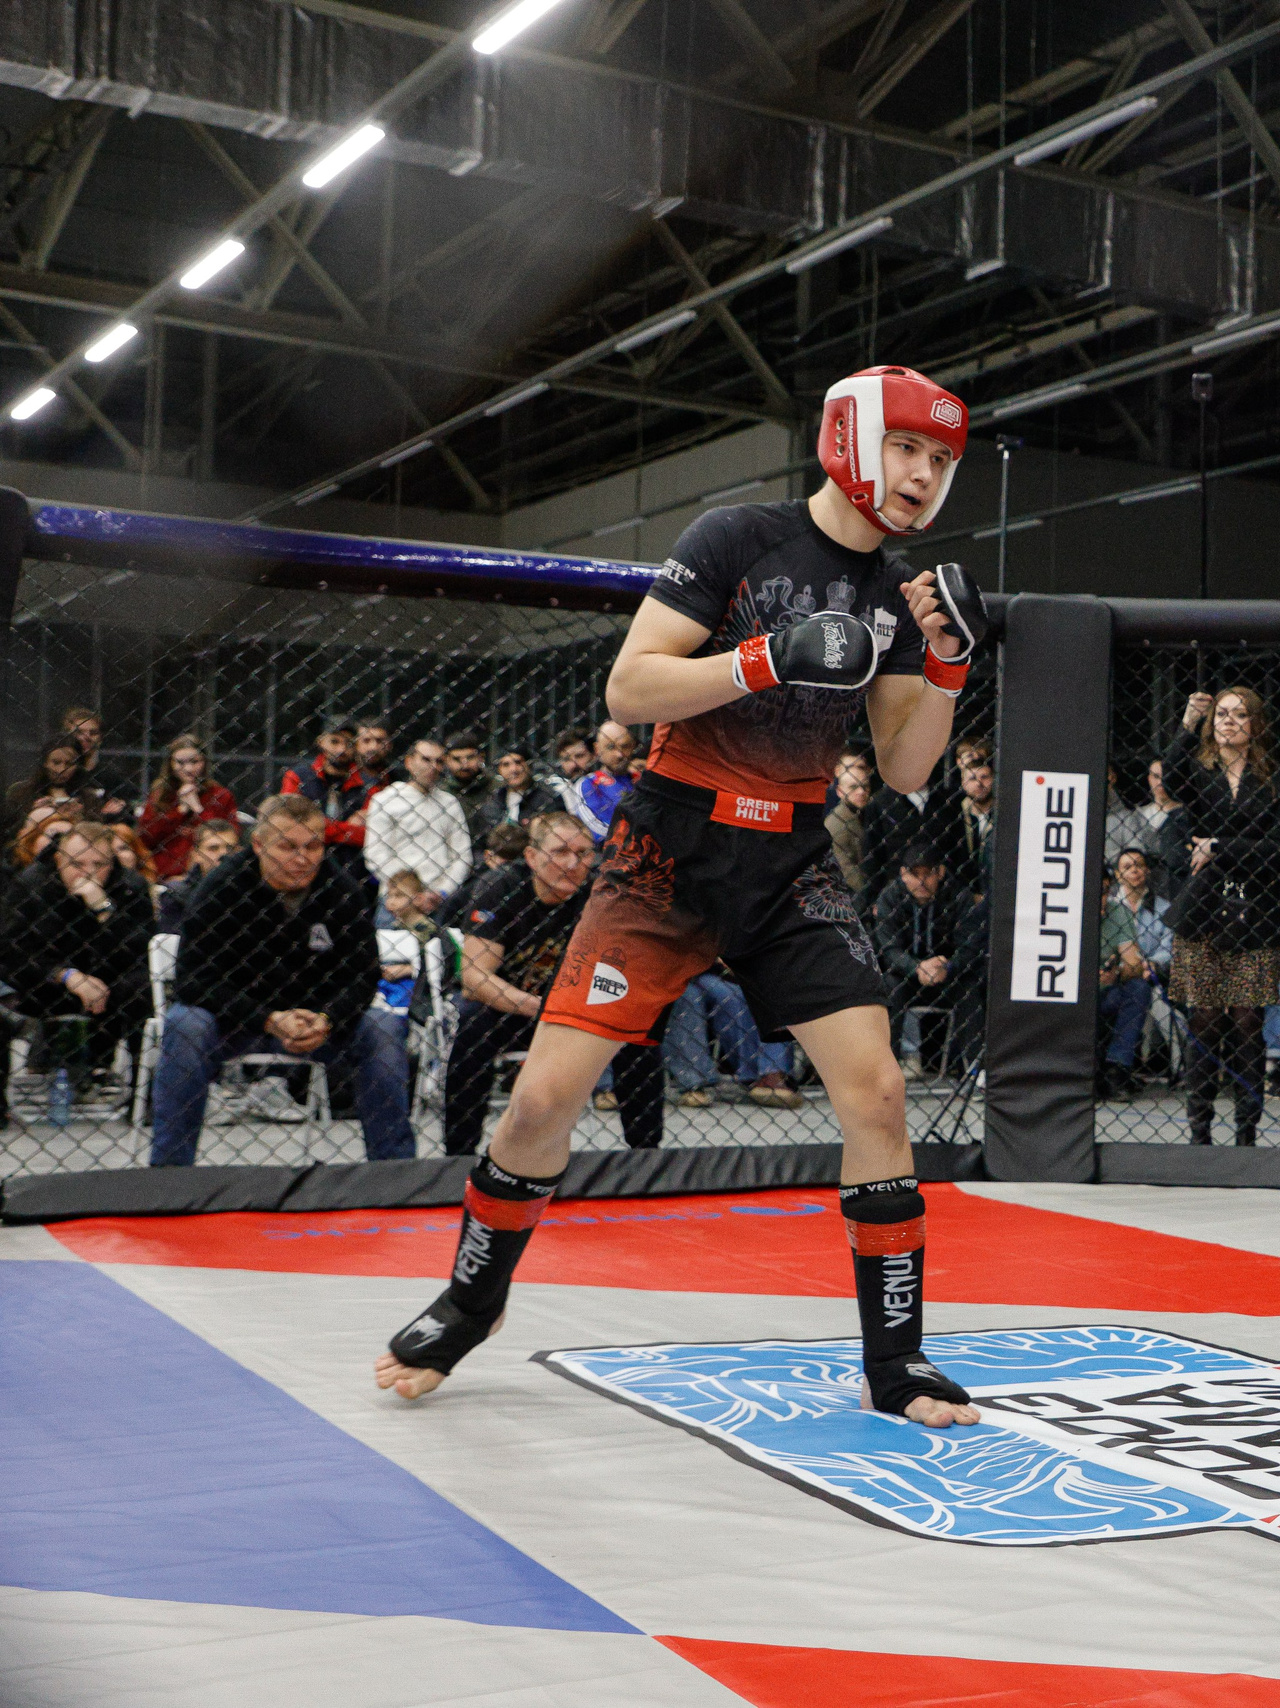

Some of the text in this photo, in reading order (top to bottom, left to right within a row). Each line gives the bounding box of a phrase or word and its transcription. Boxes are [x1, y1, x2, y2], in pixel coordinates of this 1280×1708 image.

[736, 796, 779, 812] GREEN
[735, 806, 771, 823] HILL
[1036, 786, 1075, 999] RUTUBE
[592, 980, 621, 997] HILL
[593, 975, 627, 991] GREEN
[882, 1252, 918, 1329] VENU
